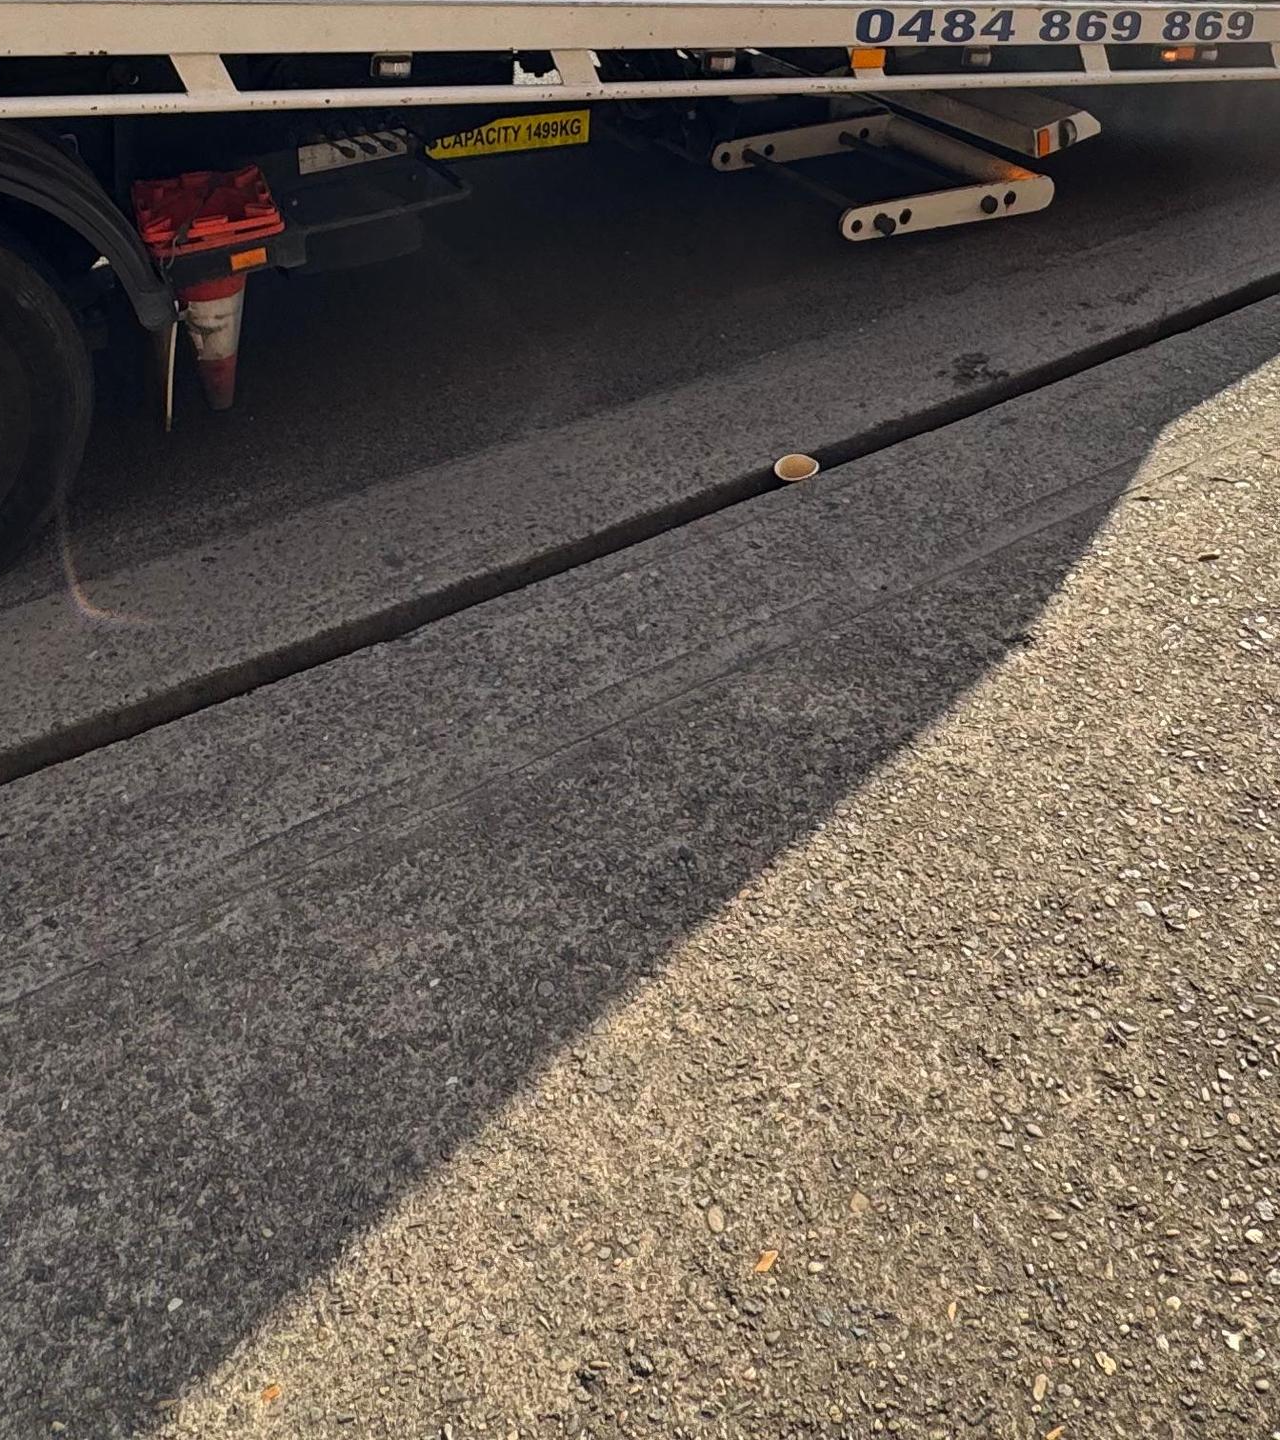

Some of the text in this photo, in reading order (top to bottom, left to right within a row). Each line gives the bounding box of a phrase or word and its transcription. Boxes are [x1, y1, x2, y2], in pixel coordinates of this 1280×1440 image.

[855, 8, 1254, 43] 0484 869 869
[440, 123, 521, 150] CAPACITY
[525, 118, 581, 141] 1499KG
